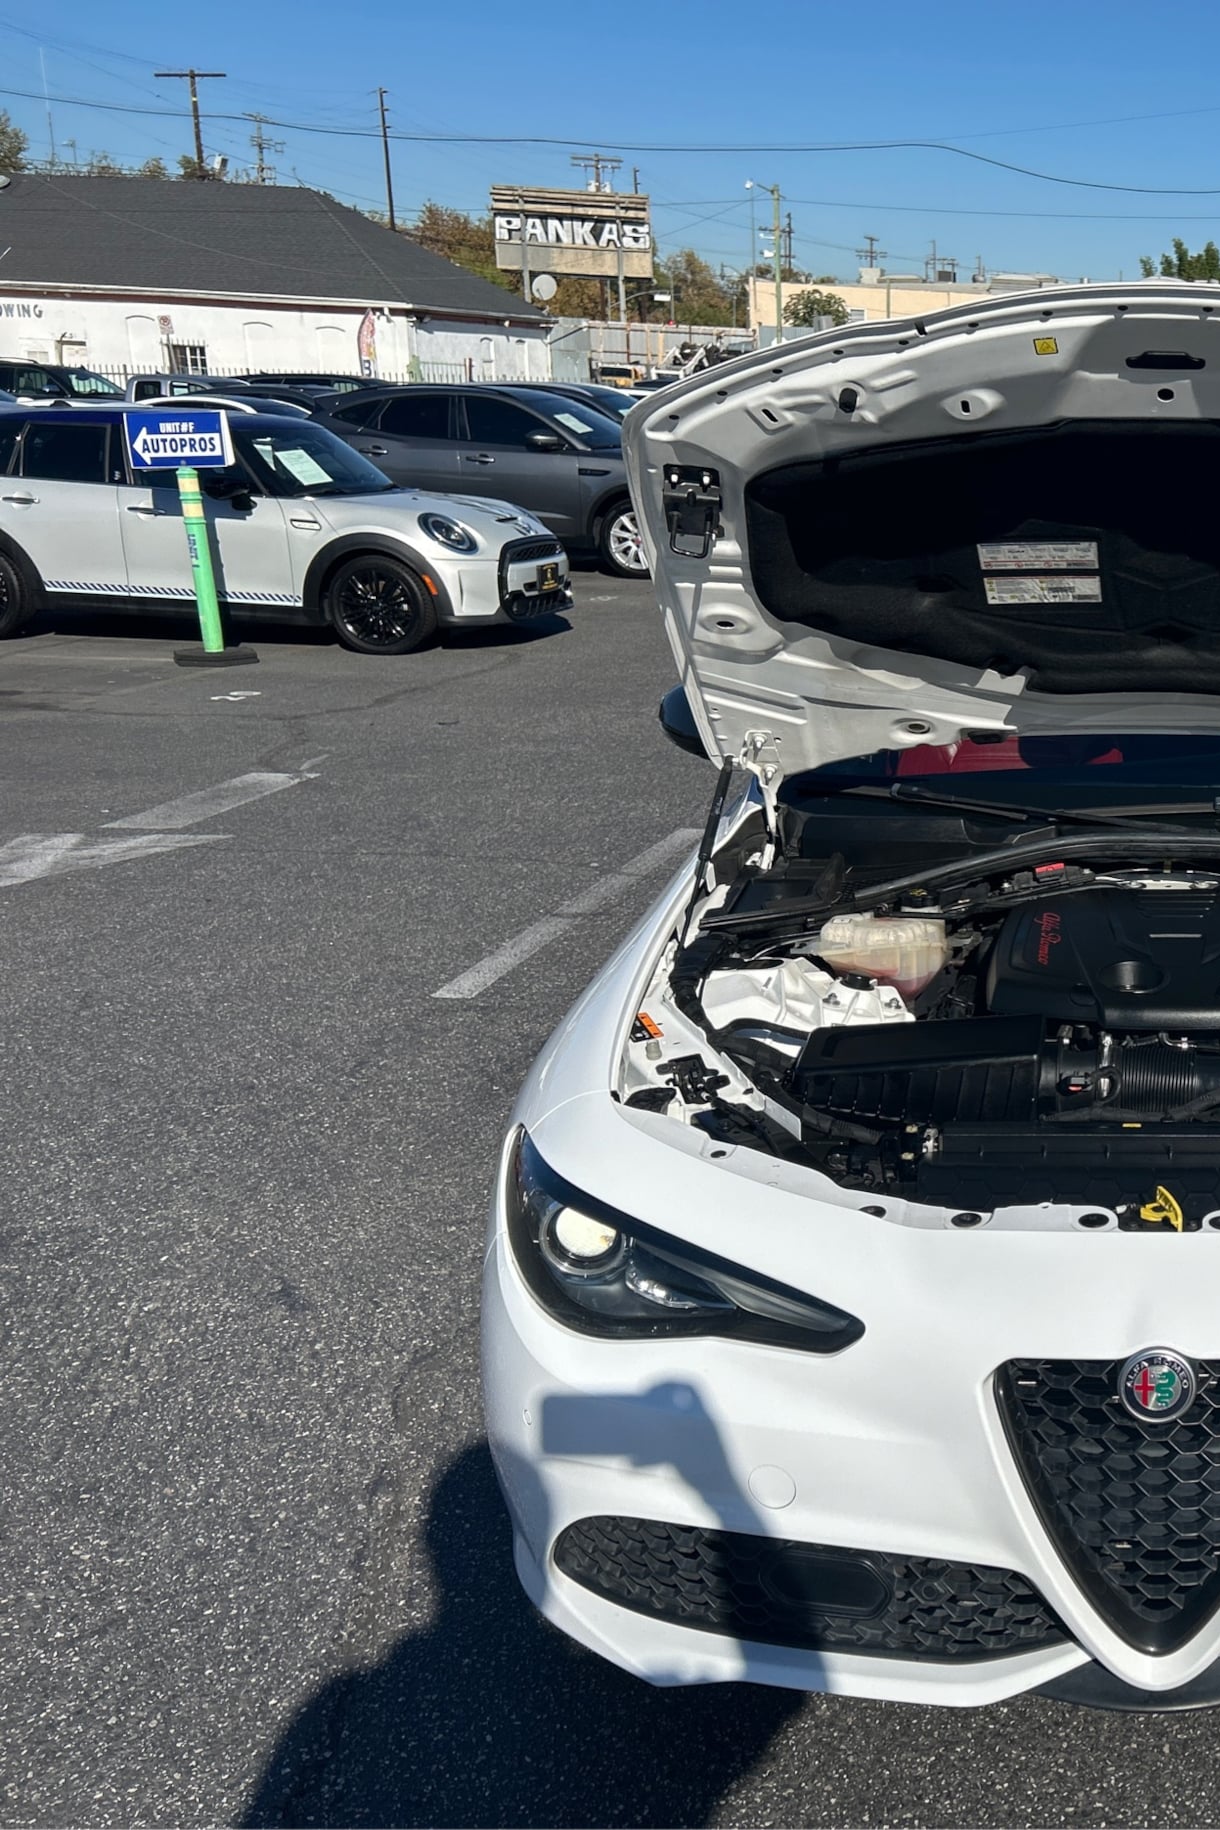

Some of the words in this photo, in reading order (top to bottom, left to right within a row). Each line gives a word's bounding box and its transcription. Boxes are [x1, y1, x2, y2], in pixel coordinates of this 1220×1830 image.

[494, 215, 650, 249] PANKAS
[142, 437, 216, 453] AUTOPROS
[1126, 1360, 1149, 1388] ALFA
[1153, 1357, 1189, 1389] ROMEO
